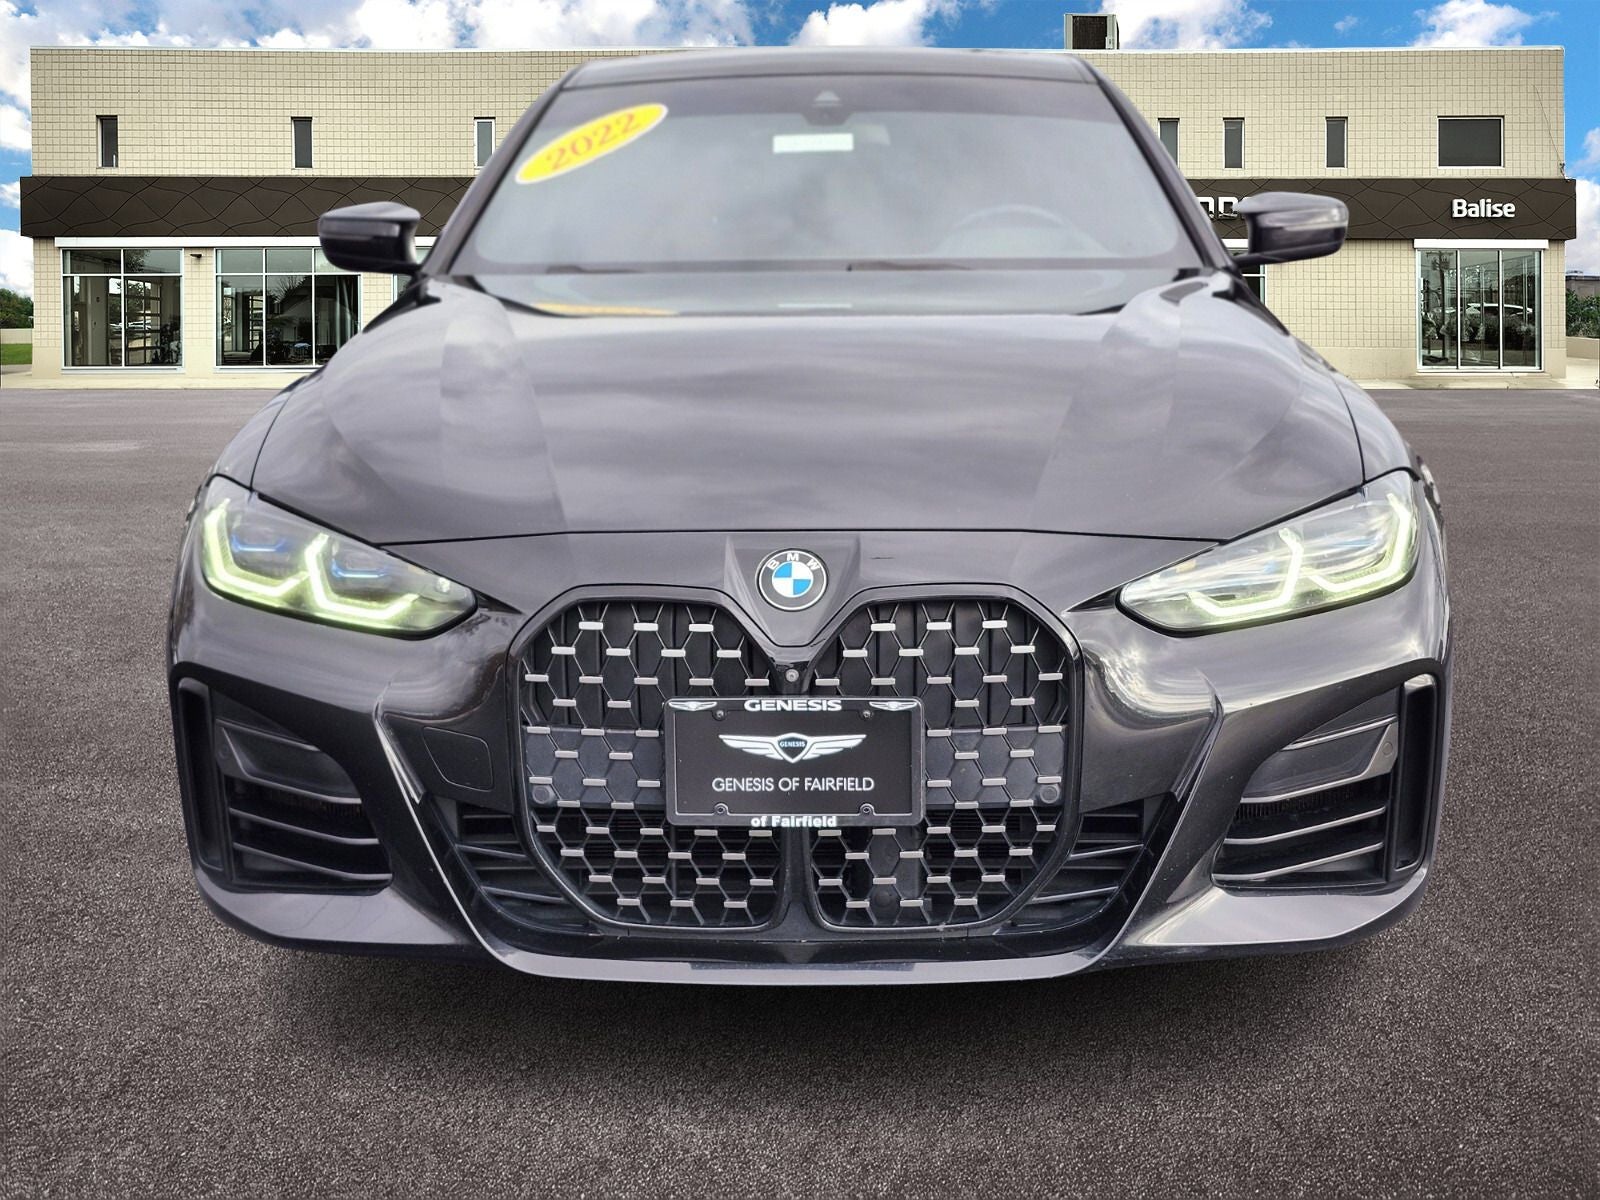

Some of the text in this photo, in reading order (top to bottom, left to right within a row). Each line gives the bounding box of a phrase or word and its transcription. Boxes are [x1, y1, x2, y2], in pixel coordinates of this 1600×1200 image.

[546, 113, 641, 171] 2022
[1452, 198, 1516, 218] Balise
[767, 552, 820, 570] BMW
[744, 699, 843, 712] GENESIS
[711, 777, 875, 792] GENESIS OF FAIRFIELD
[750, 815, 837, 828] of Fairfield
